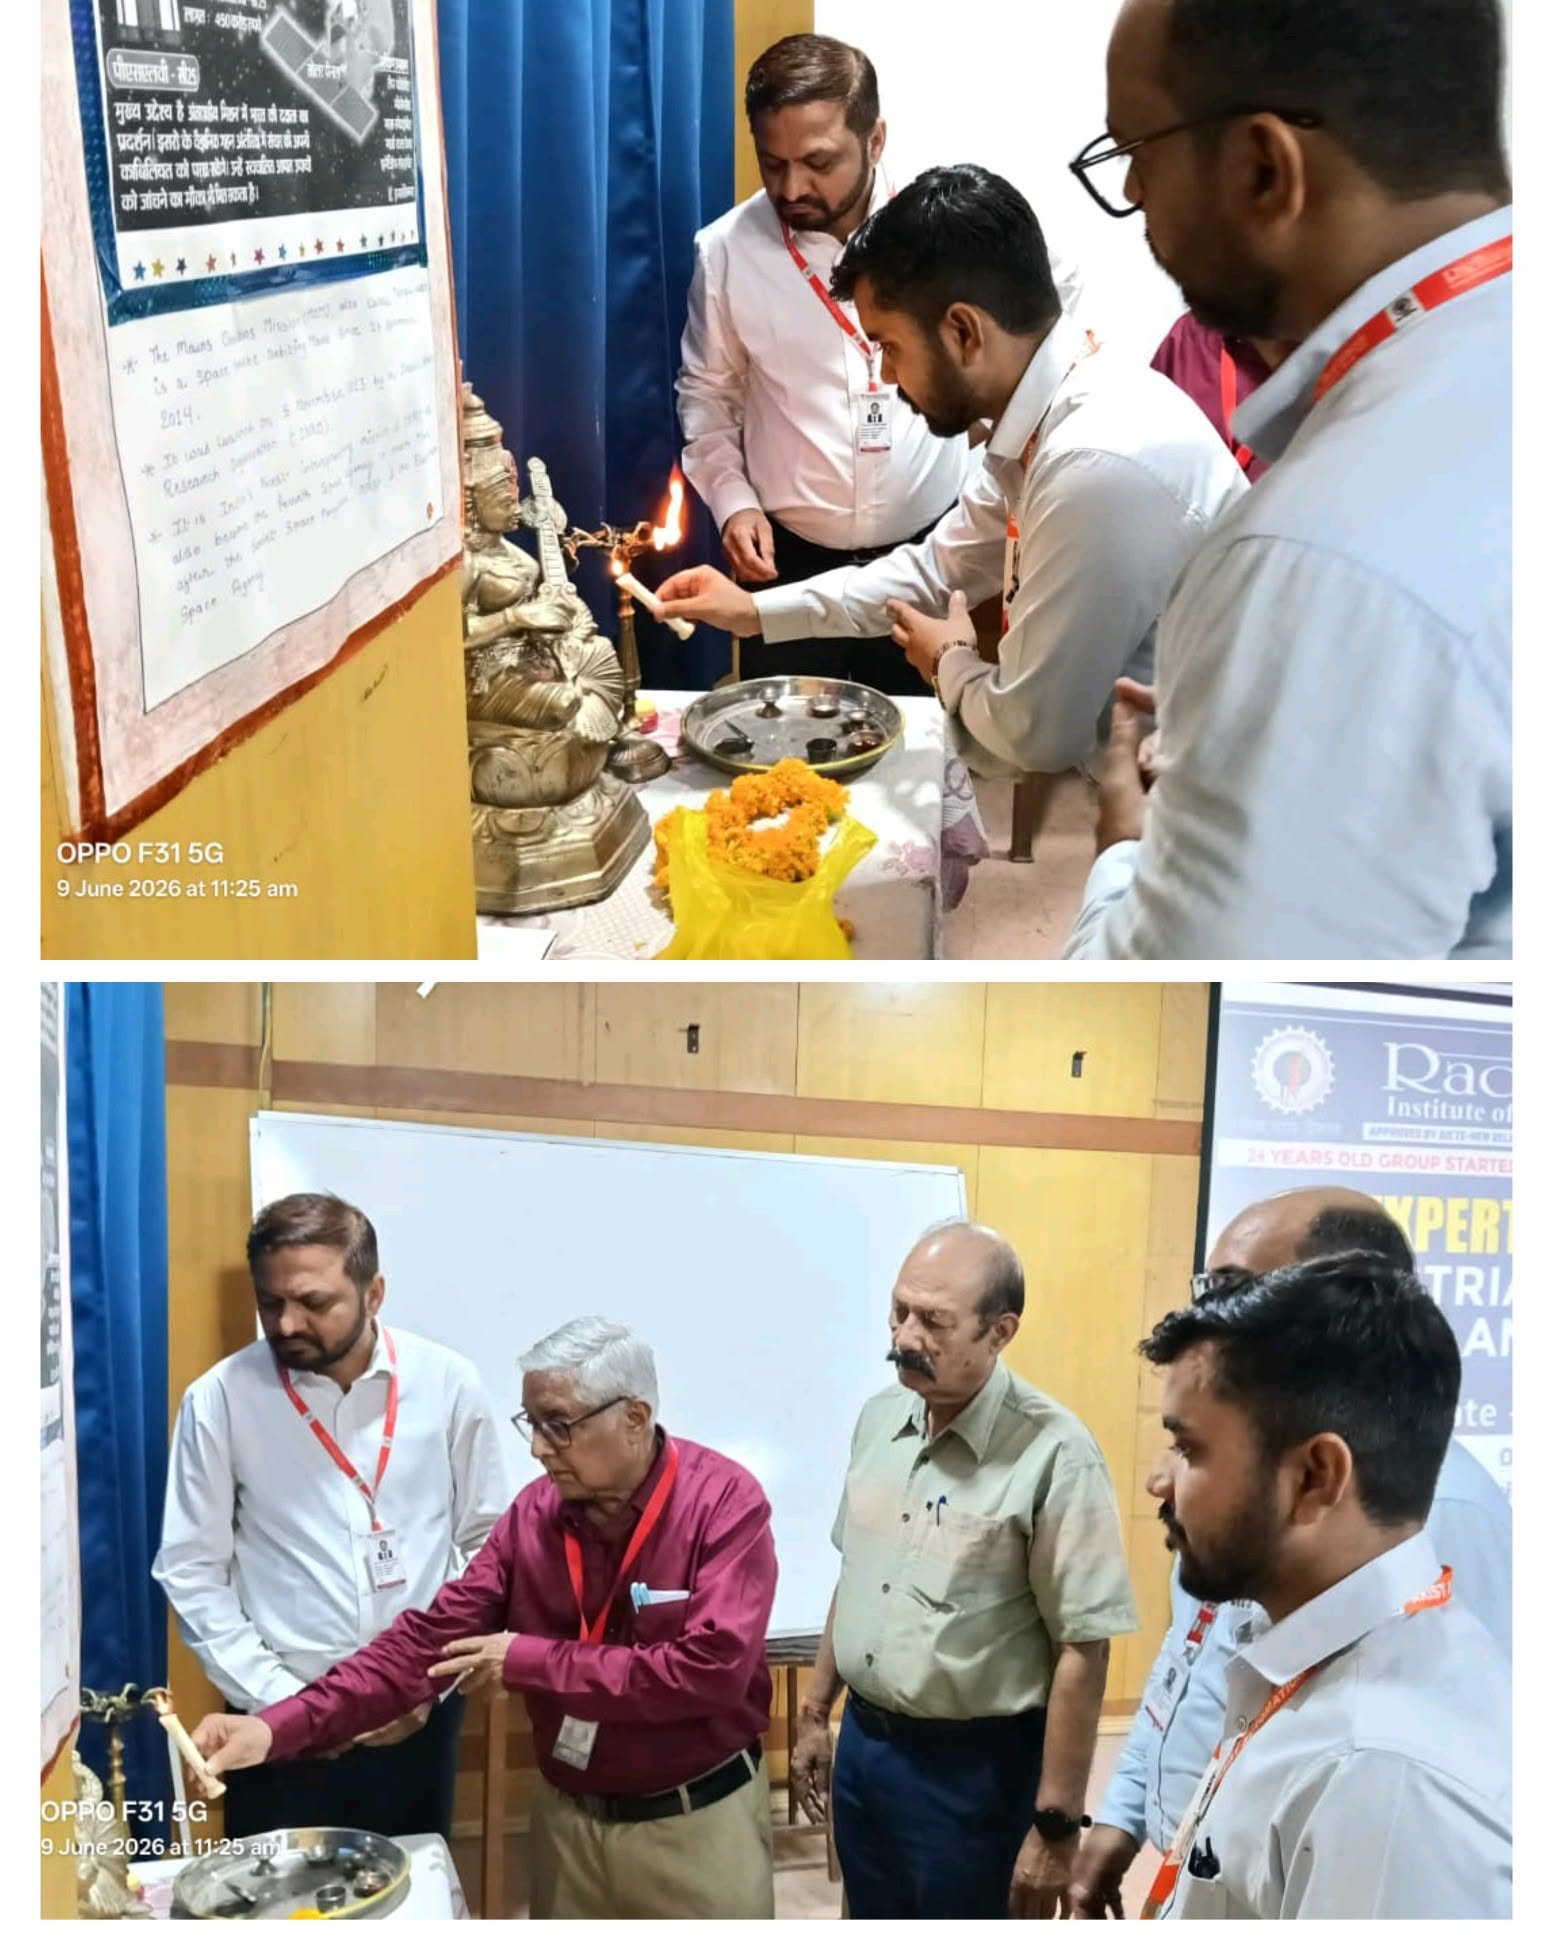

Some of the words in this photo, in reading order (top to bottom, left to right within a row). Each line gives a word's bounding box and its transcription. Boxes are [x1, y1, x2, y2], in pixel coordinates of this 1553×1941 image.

[1387, 1095, 1486, 1121] Institute
[1269, 1148, 1333, 1166] YEARS
[1338, 1150, 1373, 1168] OLD
[1379, 1151, 1440, 1171] GROUP
[1370, 1194, 1512, 1255] XPER
